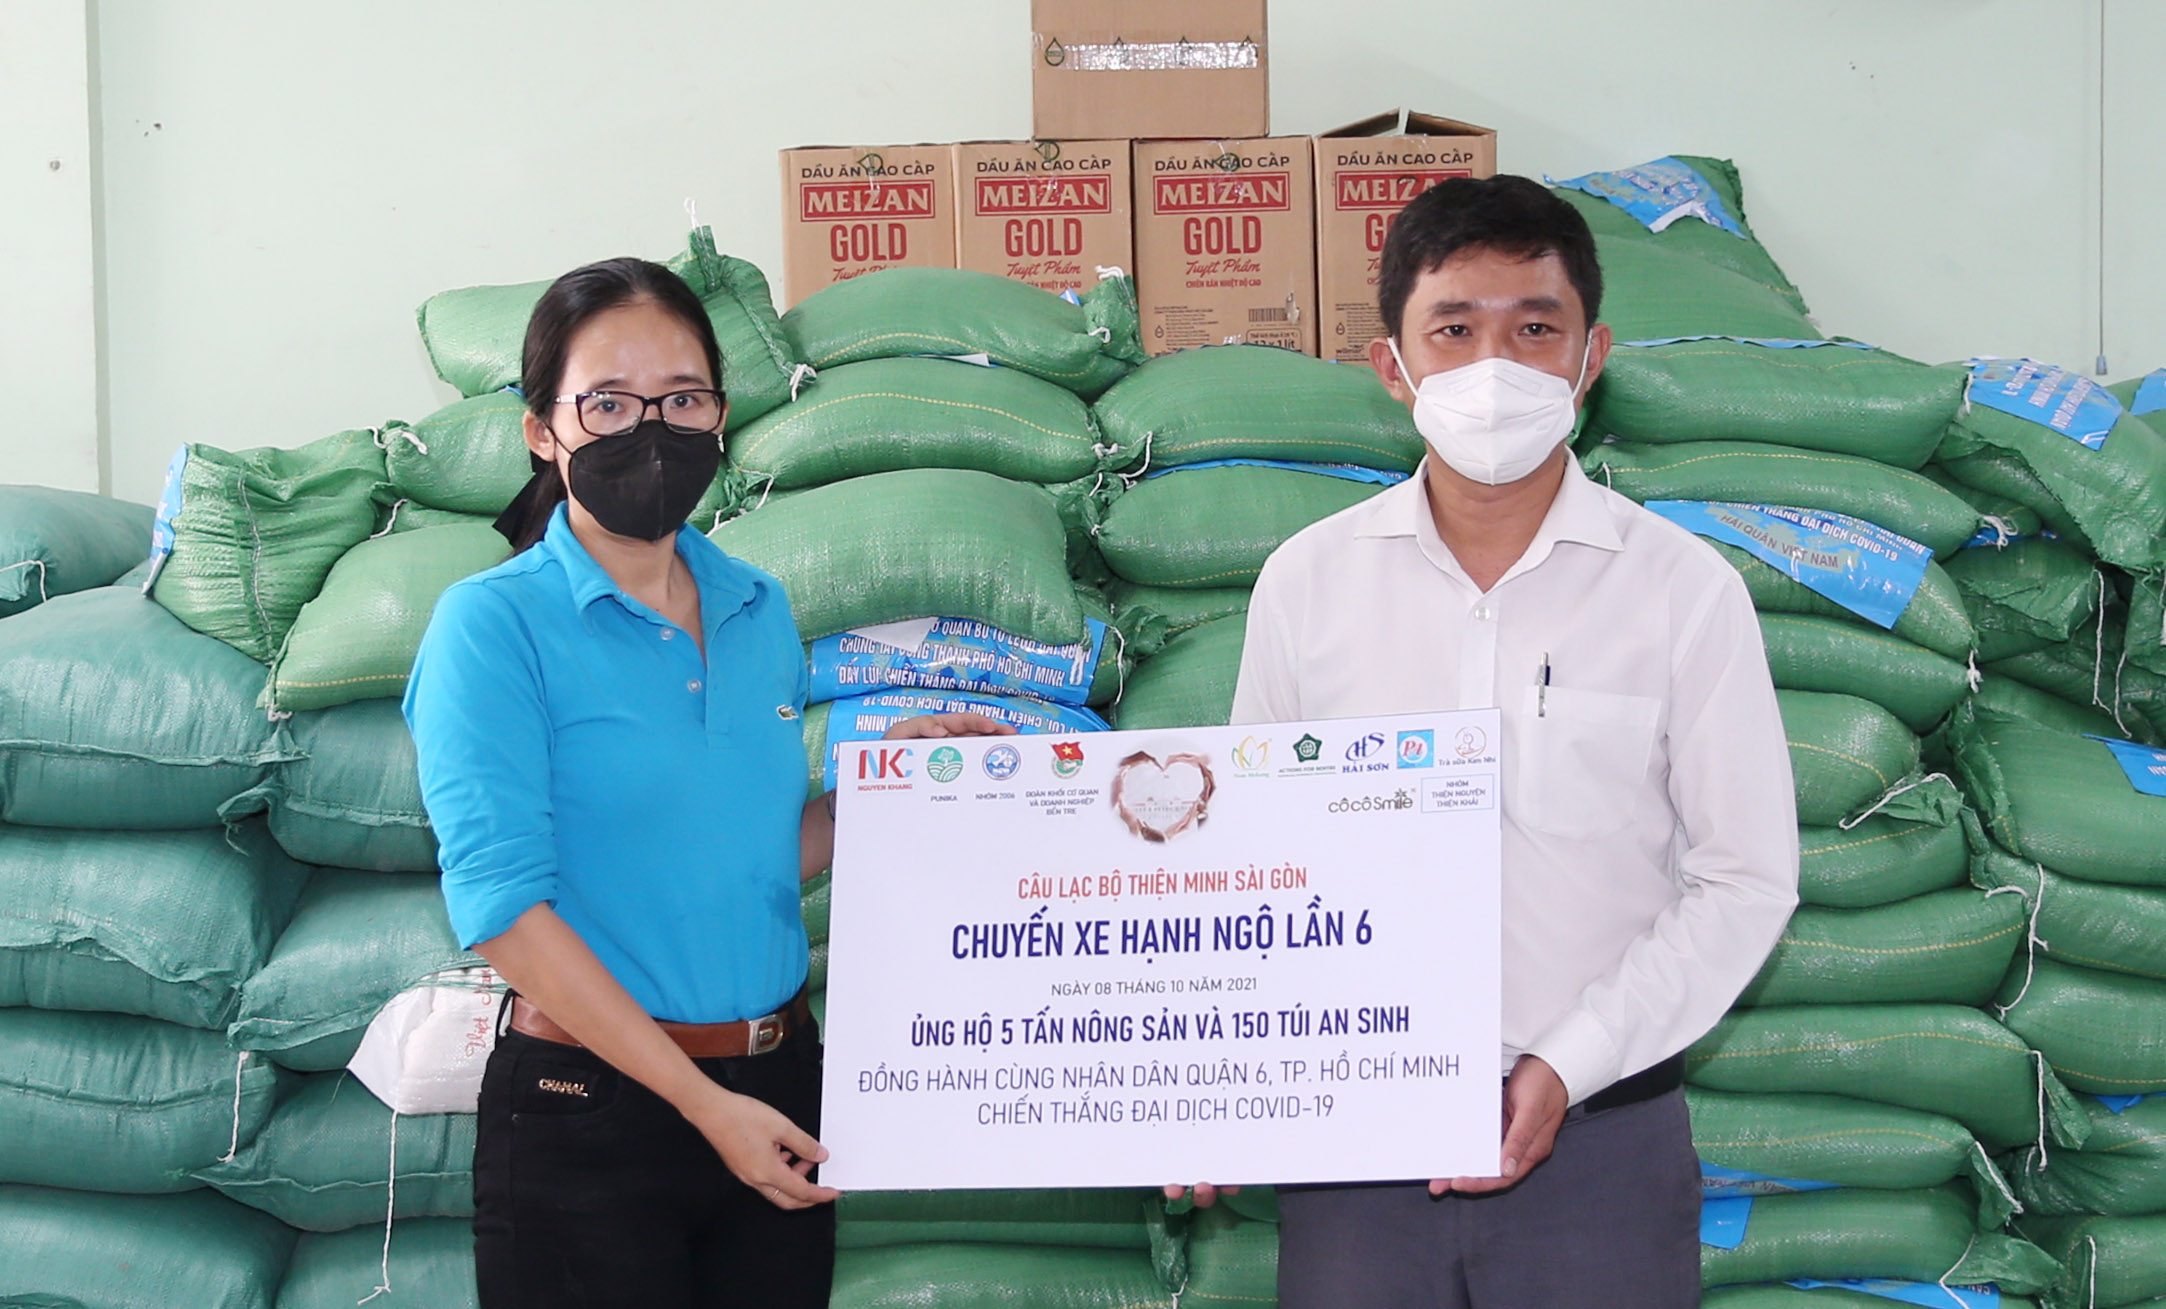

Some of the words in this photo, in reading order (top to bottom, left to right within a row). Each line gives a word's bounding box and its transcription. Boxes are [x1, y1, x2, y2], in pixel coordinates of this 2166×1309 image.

[838, 164, 860, 177] ĂN
[1014, 158, 1036, 172] ĂN
[1041, 159, 1074, 171] CAO
[1192, 156, 1214, 170] ĂN
[1219, 157, 1253, 169] CAO
[1375, 151, 1398, 165] ĂN
[1402, 153, 1436, 165] CAO
[807, 188, 929, 213] MEIZAN
[982, 182, 1105, 207] MEIZAN
[1161, 180, 1284, 206] MEIZAN
[1343, 178, 1437, 202] MEIZ
[830, 223, 907, 262] GOLD
[1005, 218, 1082, 257] GOLD
[1184, 215, 1262, 255] GOLD
[1743, 524, 1777, 549] QUÂN
[1810, 553, 1838, 568] NAM
[1850, 533, 1898, 562] COVID-19
[942, 621, 973, 637] QUAN
[839, 636, 875, 654] CHUNG
[1014, 660, 1034, 680] CHÍ
[1034, 666, 1066, 687] MINH
[856, 714, 887, 732] MINH
[1342, 761, 1363, 773] HẢI
[1366, 763, 1389, 772] SƠN
[1078, 788, 1099, 796] QUAN
[1063, 807, 1076, 815] TRE
[1018, 872, 1053, 900] CÂU
[1058, 876, 1092, 904] LẠC
[1099, 869, 1122, 902] BỘ
[1128, 869, 1177, 901] THIỆN
[1183, 870, 1229, 893] MINH
[1235, 863, 1264, 892] SÀI
[1270, 861, 1308, 889] GÒN
[952, 905, 1064, 960] CHUYẾN
[1074, 920, 1110, 956] XE
[1121, 917, 1201, 963] HẠNH
[1213, 904, 1274, 960] NGỘ
[1286, 895, 1344, 949] LẦN
[1356, 909, 1373, 945] 6
[1051, 980, 1091, 996] NGÀY
[1095, 981, 1112, 995] 08
[1116, 977, 1166, 994] THÁNG
[1170, 980, 1184, 993] 10
[1190, 976, 1222, 992] NĂM
[1227, 978, 1257, 992] 2021
[911, 1013, 955, 1047] ỦNG
[964, 1011, 992, 1053] HỘ
[1002, 1018, 1013, 1045] 5
[1022, 1005, 1063, 1044] TẤN
[1072, 1009, 1133, 1043] NÔNG
[1142, 1007, 1187, 1042] SẢN
[1195, 1006, 1224, 1040] VÀ
[1231, 1011, 1269, 1039] 150
[1277, 1002, 1310, 1037] TÚI
[1318, 1008, 1349, 1036] AN
[1357, 1005, 1410, 1034] SINH
[858, 1062, 919, 1092] ĐỒNG
[927, 1064, 987, 1091] HÀNH
[995, 1062, 1054, 1090] CÙNG
[1063, 1061, 1124, 1089] NHÂN
[1133, 1059, 1178, 1087] DÂN
[1186, 1058, 1248, 1090] QUẬN
[1256, 1061, 1272, 1086] 6,
[1280, 1060, 1312, 1083] TP.
[1320, 1049, 1350, 1082] HỒ
[1358, 1051, 1395, 1080] CHÍ
[1402, 1054, 1460, 1078] MINH
[978, 1093, 1042, 1125] CHIẾN
[1049, 1091, 1123, 1123] THẮNG
[1131, 1099, 1167, 1127] ĐẠI
[1176, 1098, 1227, 1126] DỊCH
[1235, 1094, 1334, 1120] COVID-19
